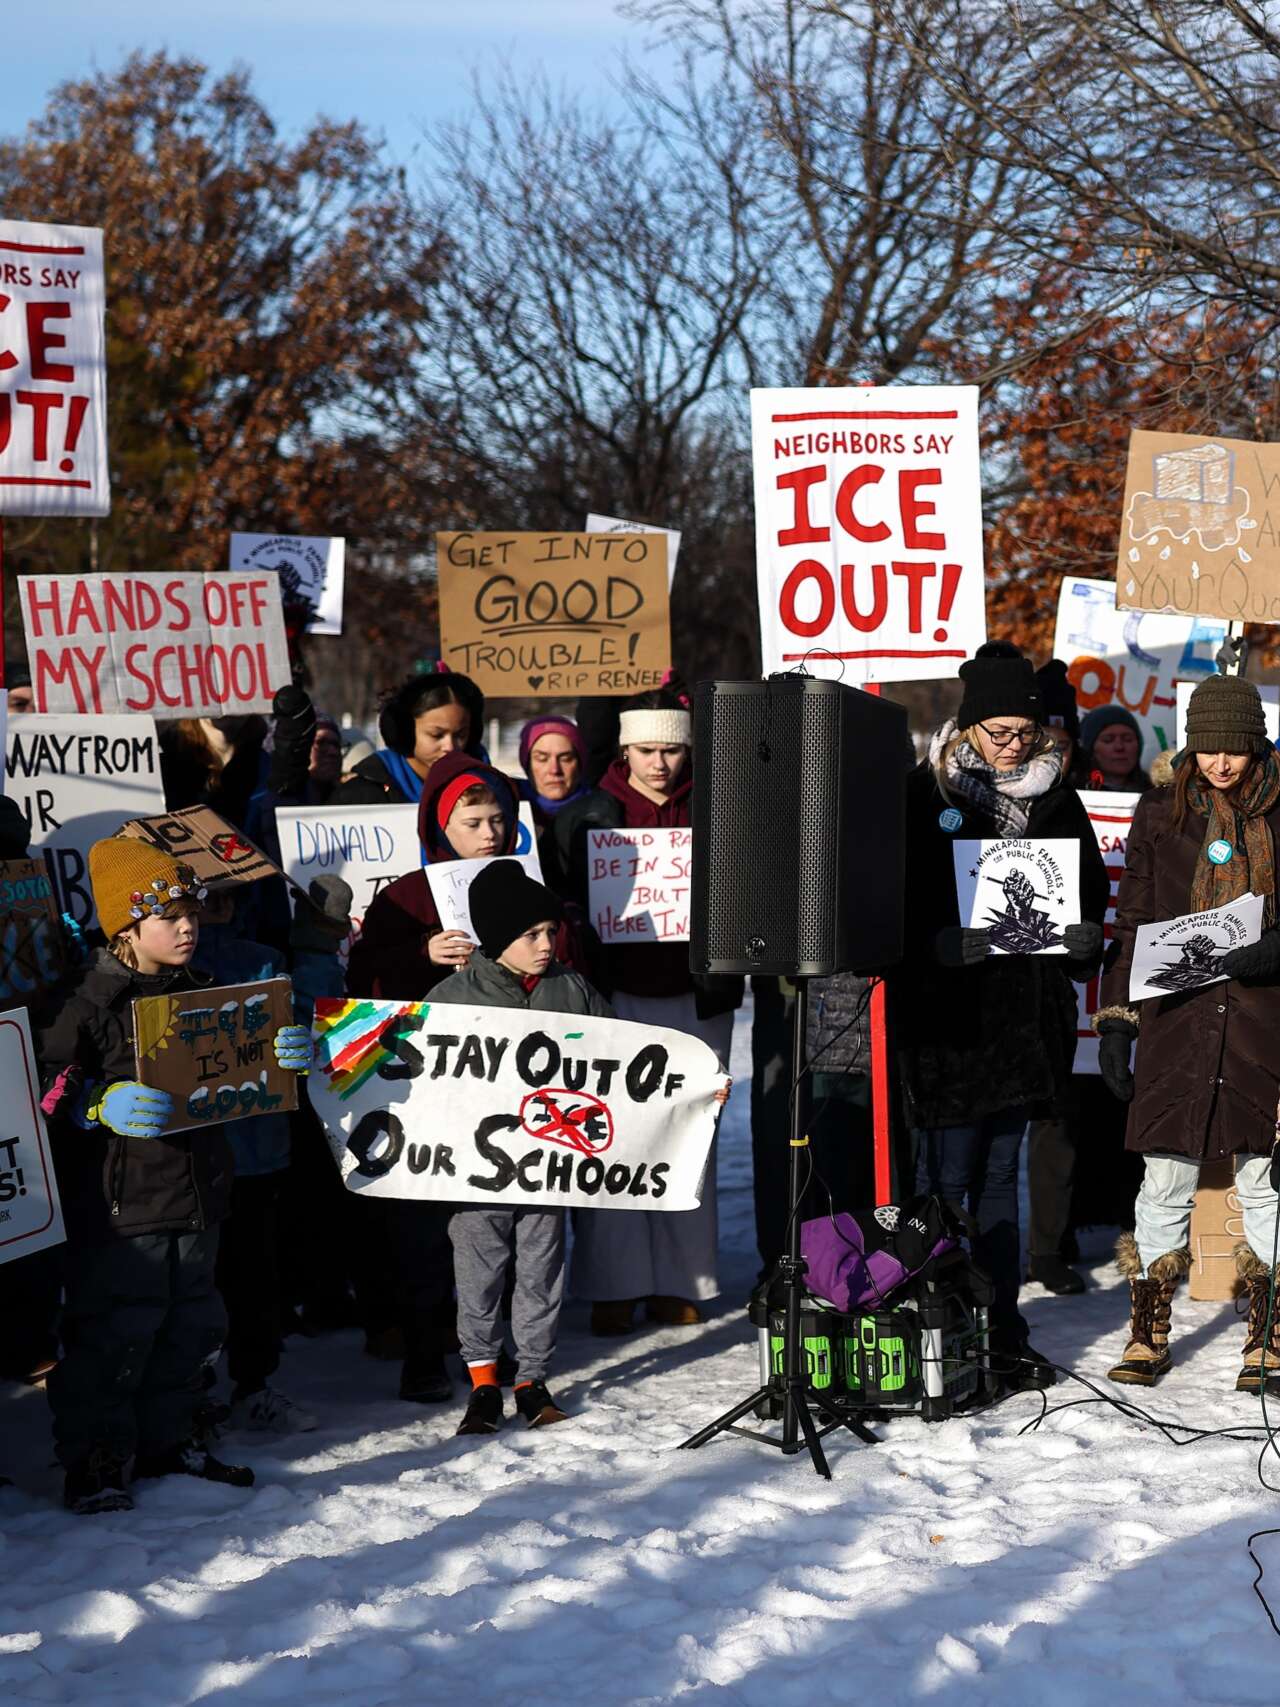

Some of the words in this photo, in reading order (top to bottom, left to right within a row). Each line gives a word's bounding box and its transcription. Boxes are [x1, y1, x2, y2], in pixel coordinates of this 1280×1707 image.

[0, 262, 32, 287] RS
[40, 267, 81, 289] SAY
[0, 389, 90, 473] T!
[773, 431, 906, 459] NEIGHBORS
[913, 434, 954, 454] SAY
[776, 464, 947, 550] ICE
[447, 533, 517, 568] GET
[533, 537, 648, 564] INTO
[26, 579, 192, 638] HANDS
[205, 580, 269, 628] OFF
[474, 574, 645, 624] GOOD
[778, 559, 963, 643] OUT!
[449, 632, 641, 674] TROUBLE!
[35, 645, 107, 714] MY
[124, 642, 278, 712] SCHOOL
[549, 672, 588, 689] RIP
[597, 669, 663, 690] RENEE
[78, 735, 154, 775] FROM
[295, 820, 395, 868] DONALD
[591, 831, 655, 849] WOULD
[591, 857, 622, 880] BE
[628, 856, 659, 877] IN
[976, 839, 1032, 867] MINNEAPOLIS
[1038, 848, 1064, 889] FAMILIES
[1006, 849, 1035, 862] PUBLIC
[1036, 859, 1055, 895] SCHOOLS
[632, 886, 689, 905] BUT
[597, 904, 649, 940] HERE
[1158, 912, 1219, 939] MINNEAPOLIS
[1223, 913, 1248, 940] FAMILIES
[1192, 920, 1221, 929] PUBLIC
[1221, 922, 1237, 947] SCHOOLS
[179, 993, 272, 1041] ICE
[236, 1038, 270, 1068] NOT
[377, 1013, 510, 1083] STAY
[515, 1030, 621, 1098] OUT
[624, 1043, 685, 1103] OF
[186, 1069, 284, 1119] COOL
[345, 1109, 457, 1178] OUR
[466, 1113, 671, 1198] SCHOOLS
